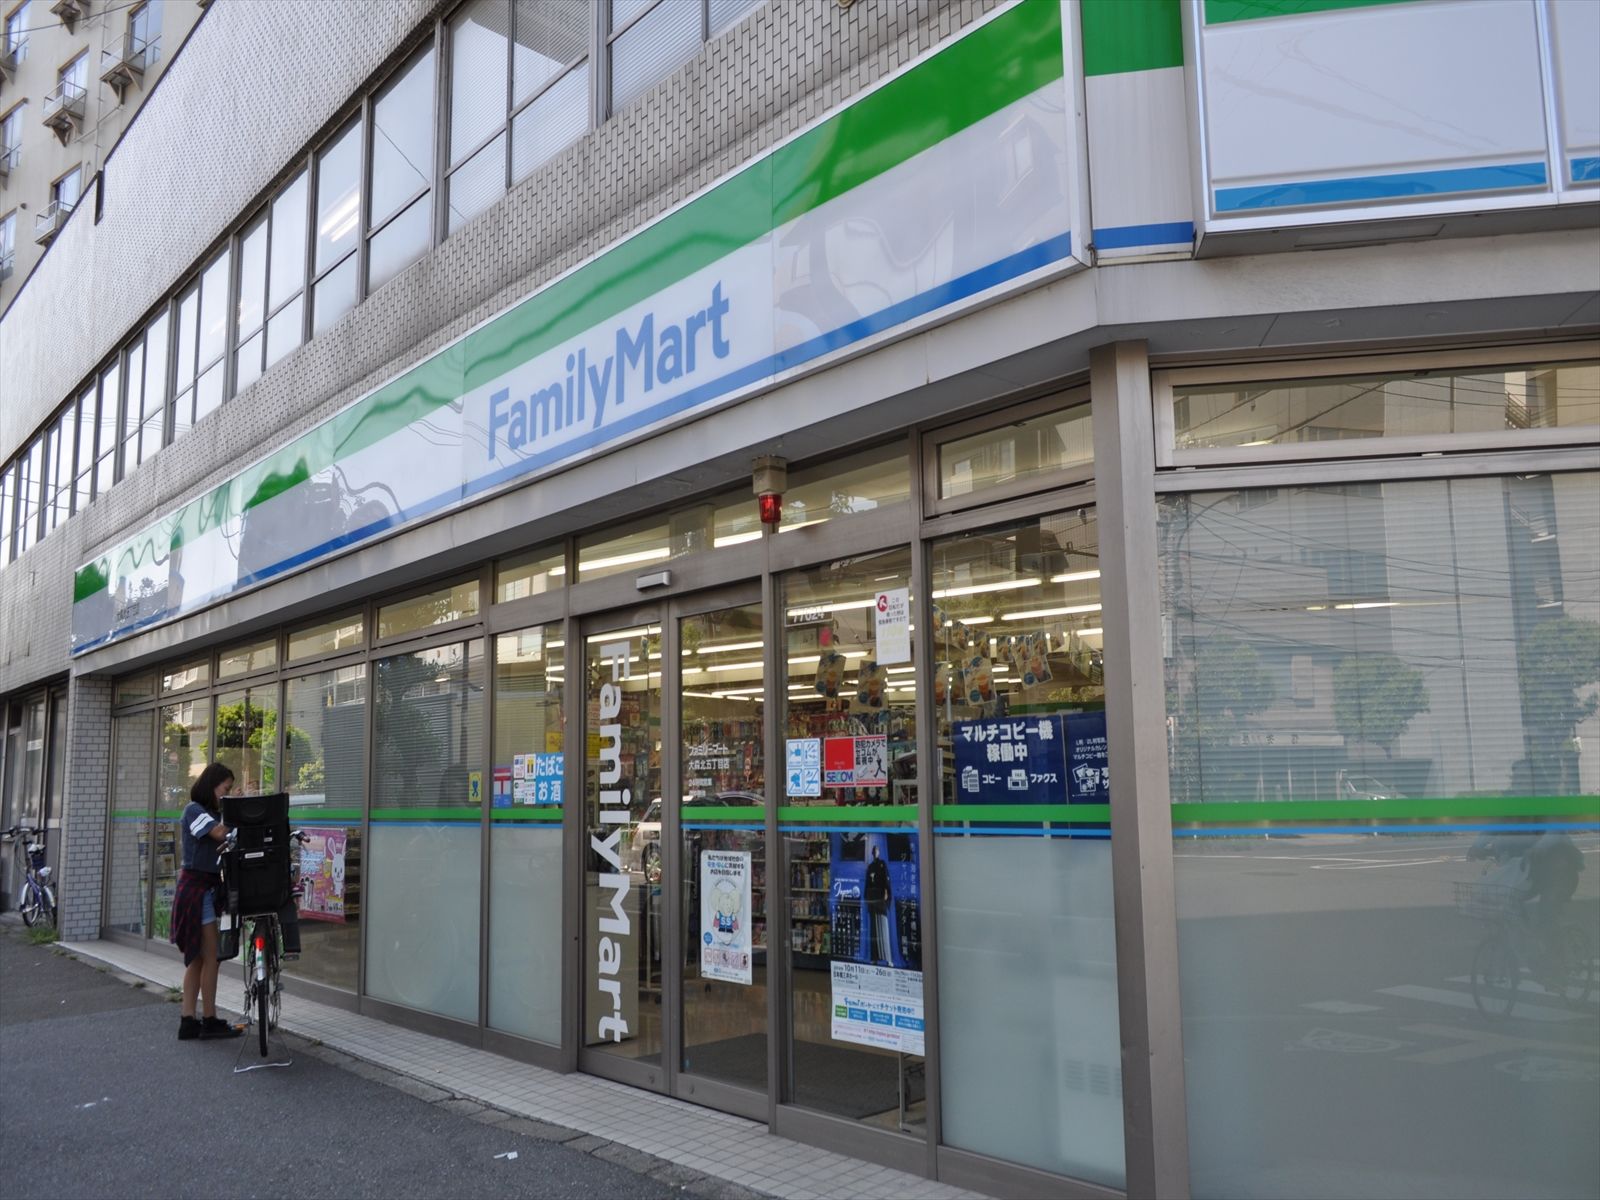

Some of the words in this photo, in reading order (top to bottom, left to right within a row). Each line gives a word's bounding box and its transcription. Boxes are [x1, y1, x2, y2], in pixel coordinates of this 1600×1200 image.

[488, 280, 730, 461] FamilyMart
[961, 720, 1054, 742] マルチコピー機
[688, 744, 729, 756] ファミリーマート
[986, 742, 1028, 763] 稼働中
[537, 756, 564, 776] たばこ
[826, 771, 854, 783] SECOM
[982, 773, 1002, 784] コピー
[1030, 773, 1058, 783] ファクス
[538, 780, 561, 801] お酒
[591, 642, 631, 1043] FamilyMart
